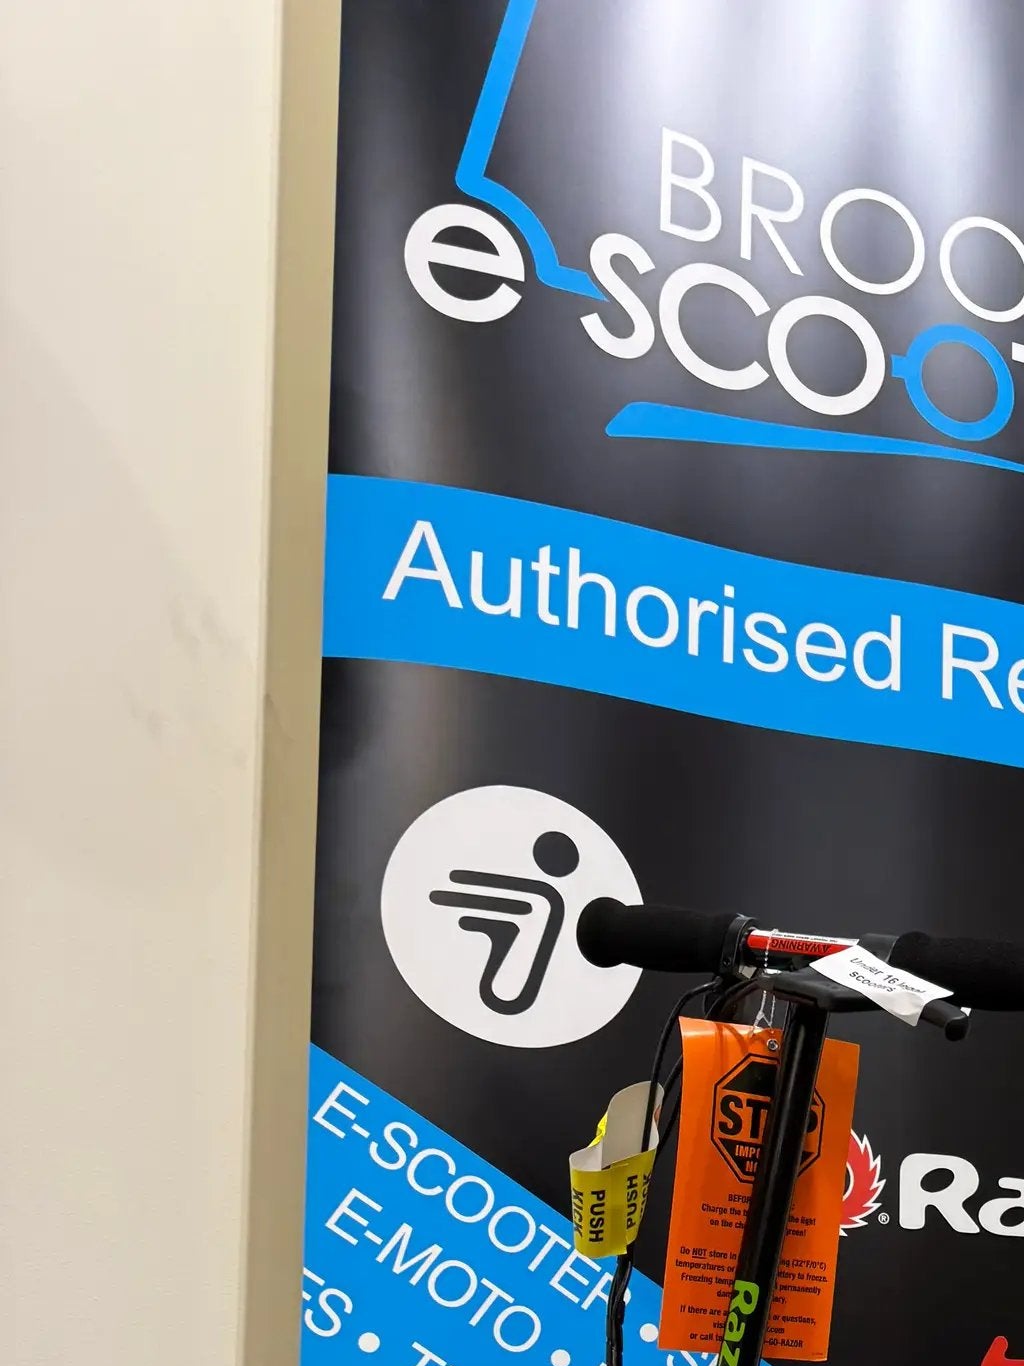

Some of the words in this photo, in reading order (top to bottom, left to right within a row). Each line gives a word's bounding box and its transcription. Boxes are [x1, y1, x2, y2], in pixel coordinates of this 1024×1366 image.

[382, 519, 903, 692] Authorised
[882, 974, 900, 985] 16
[626, 1174, 638, 1230] PUSH
[702, 1203, 728, 1215] Charge
[728, 1193, 751, 1204] BEFOR
[588, 1189, 607, 1244] PUSH
[692, 1247, 707, 1259] NOT
[324, 1188, 542, 1353] E-MOTO
